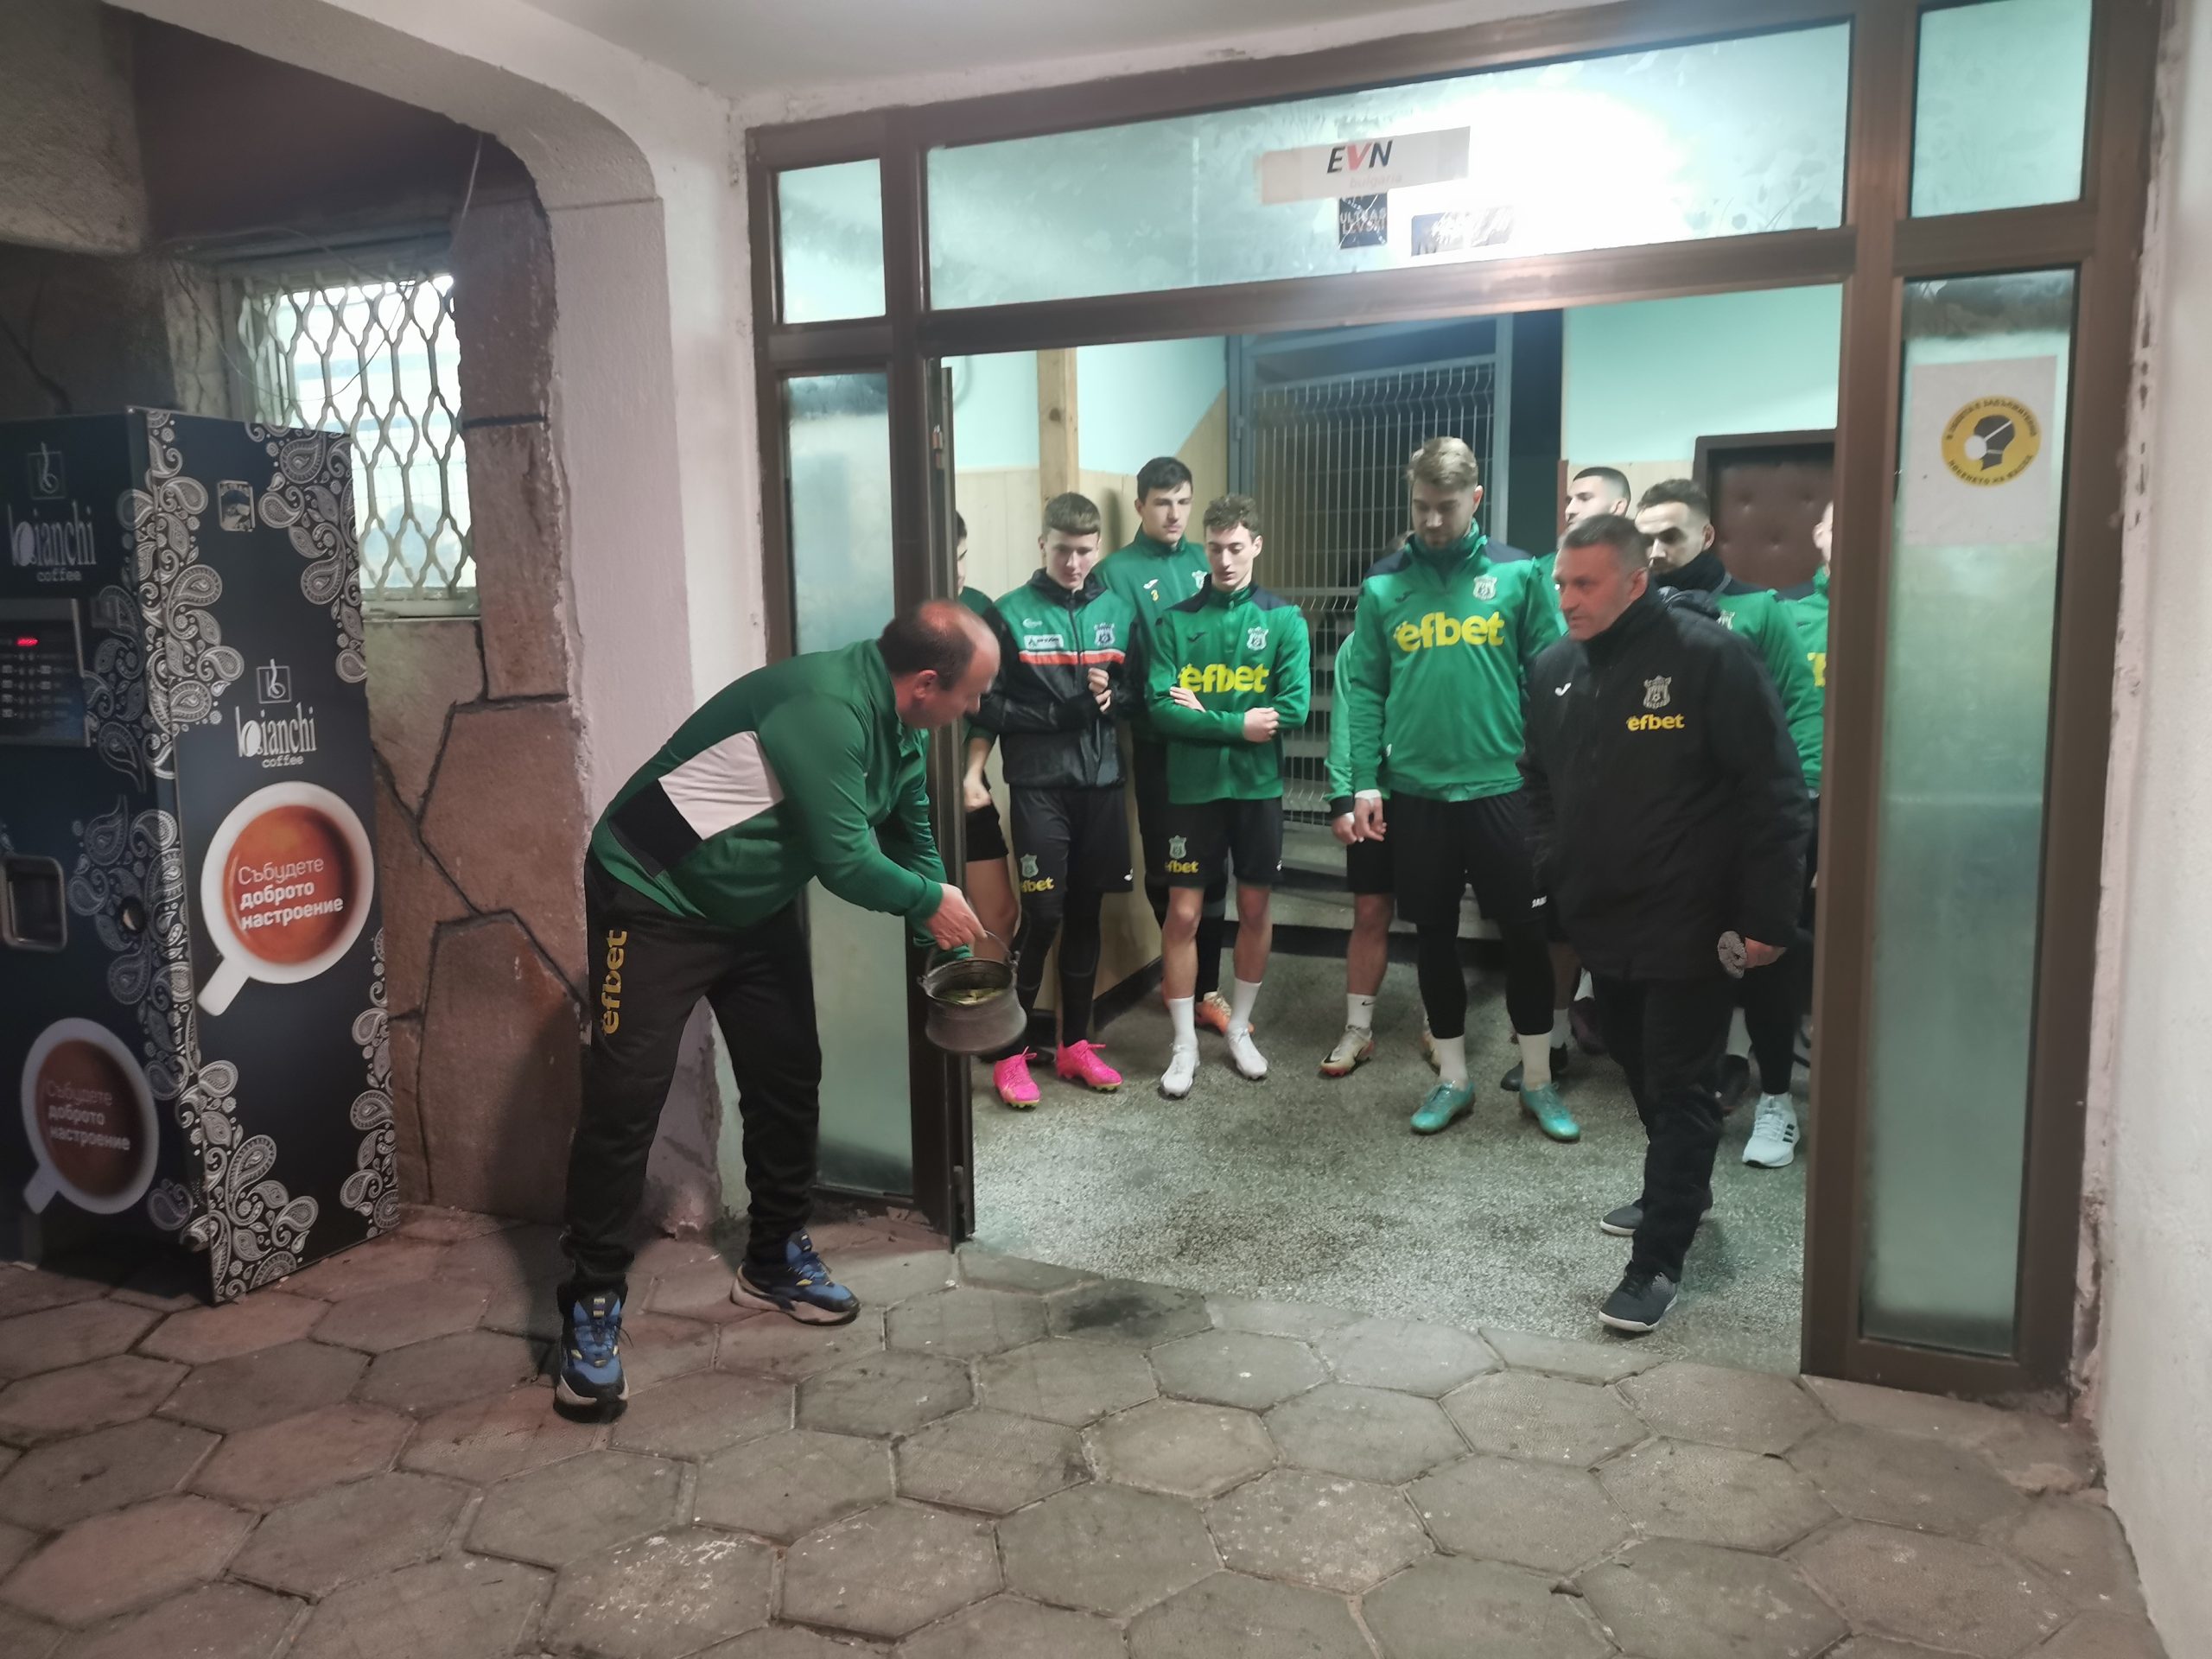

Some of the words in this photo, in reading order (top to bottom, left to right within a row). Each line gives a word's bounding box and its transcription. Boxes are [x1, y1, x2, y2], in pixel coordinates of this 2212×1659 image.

[1326, 140, 1393, 174] EVN
[7, 499, 97, 566] bianchi
[36, 567, 83, 582] coffee
[1392, 611, 1505, 652] efbet
[1178, 663, 1269, 693] efbet
[235, 702, 317, 758] bianchi
[1626, 713, 1685, 731] efbet
[261, 753, 304, 768] coffee
[238, 858, 324, 885] Събудете
[1021, 876, 1054, 893] fbet
[240, 881, 315, 911] доброто
[241, 898, 344, 930] настроение
[601, 930, 628, 1035] efbet
